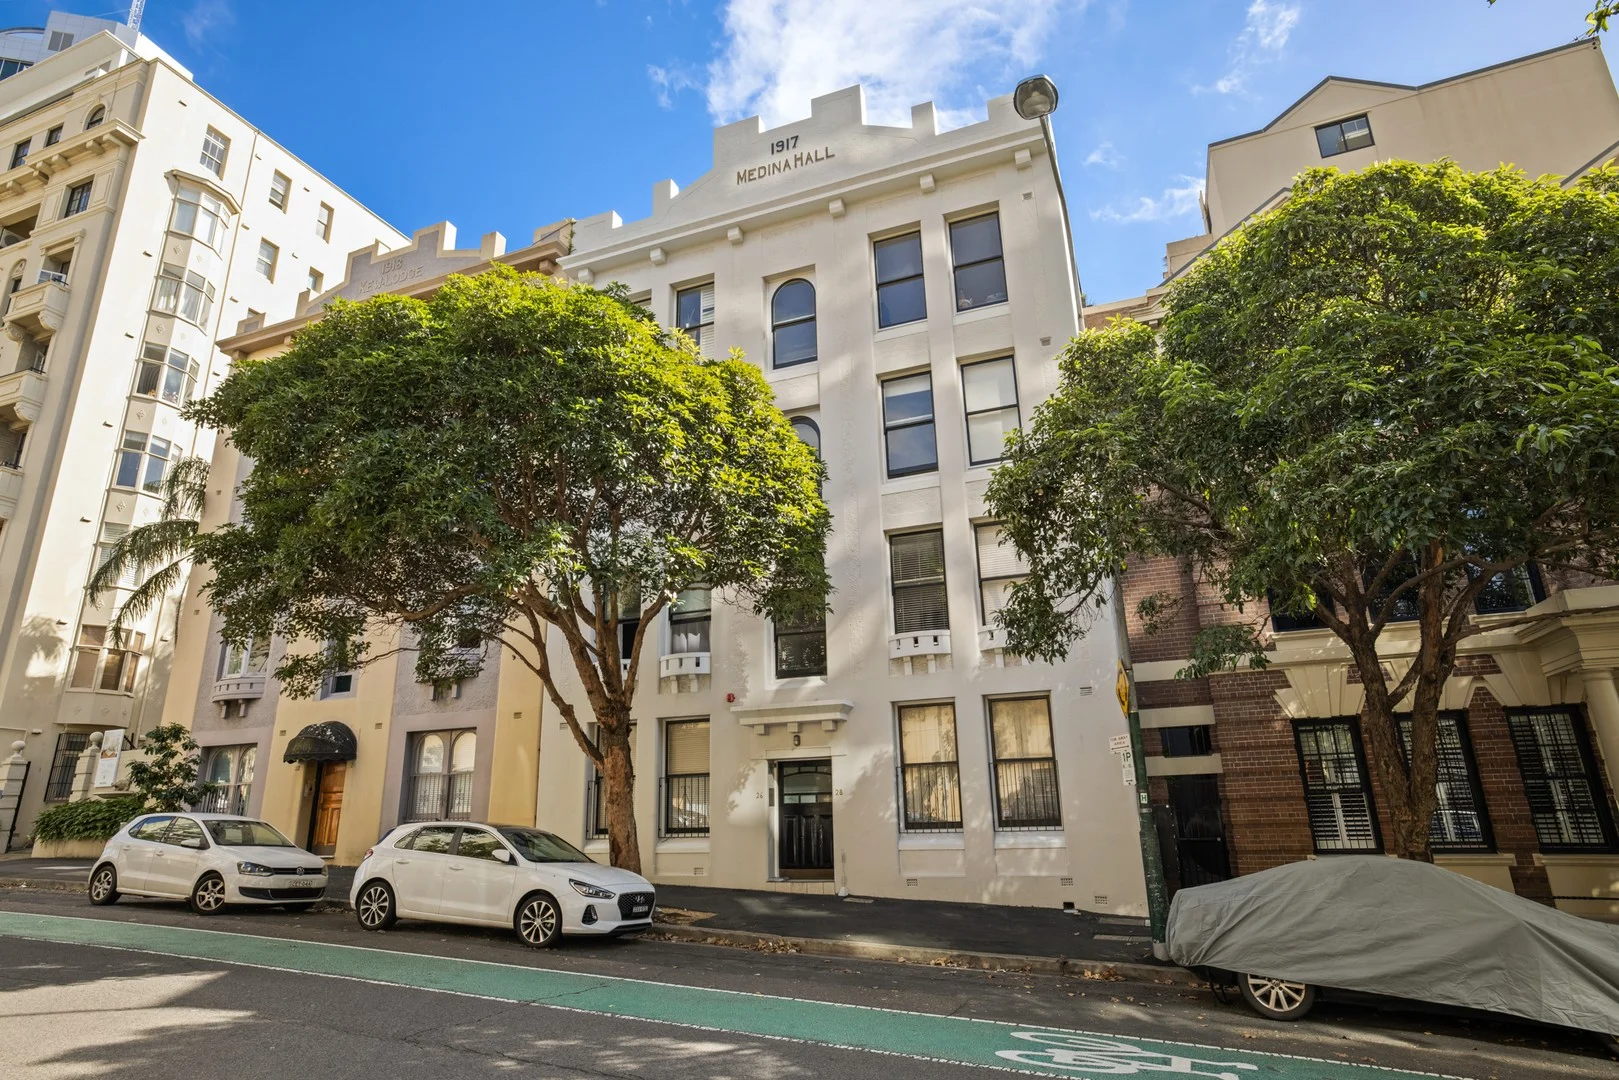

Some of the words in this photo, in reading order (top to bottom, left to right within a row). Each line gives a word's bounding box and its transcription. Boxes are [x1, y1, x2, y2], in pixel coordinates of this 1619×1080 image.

[771, 135, 799, 155] 1917
[736, 158, 791, 185] MEDINA
[794, 146, 835, 168] HALL
[382, 259, 403, 274] 1918
[1122, 751, 1131, 762] 1P
